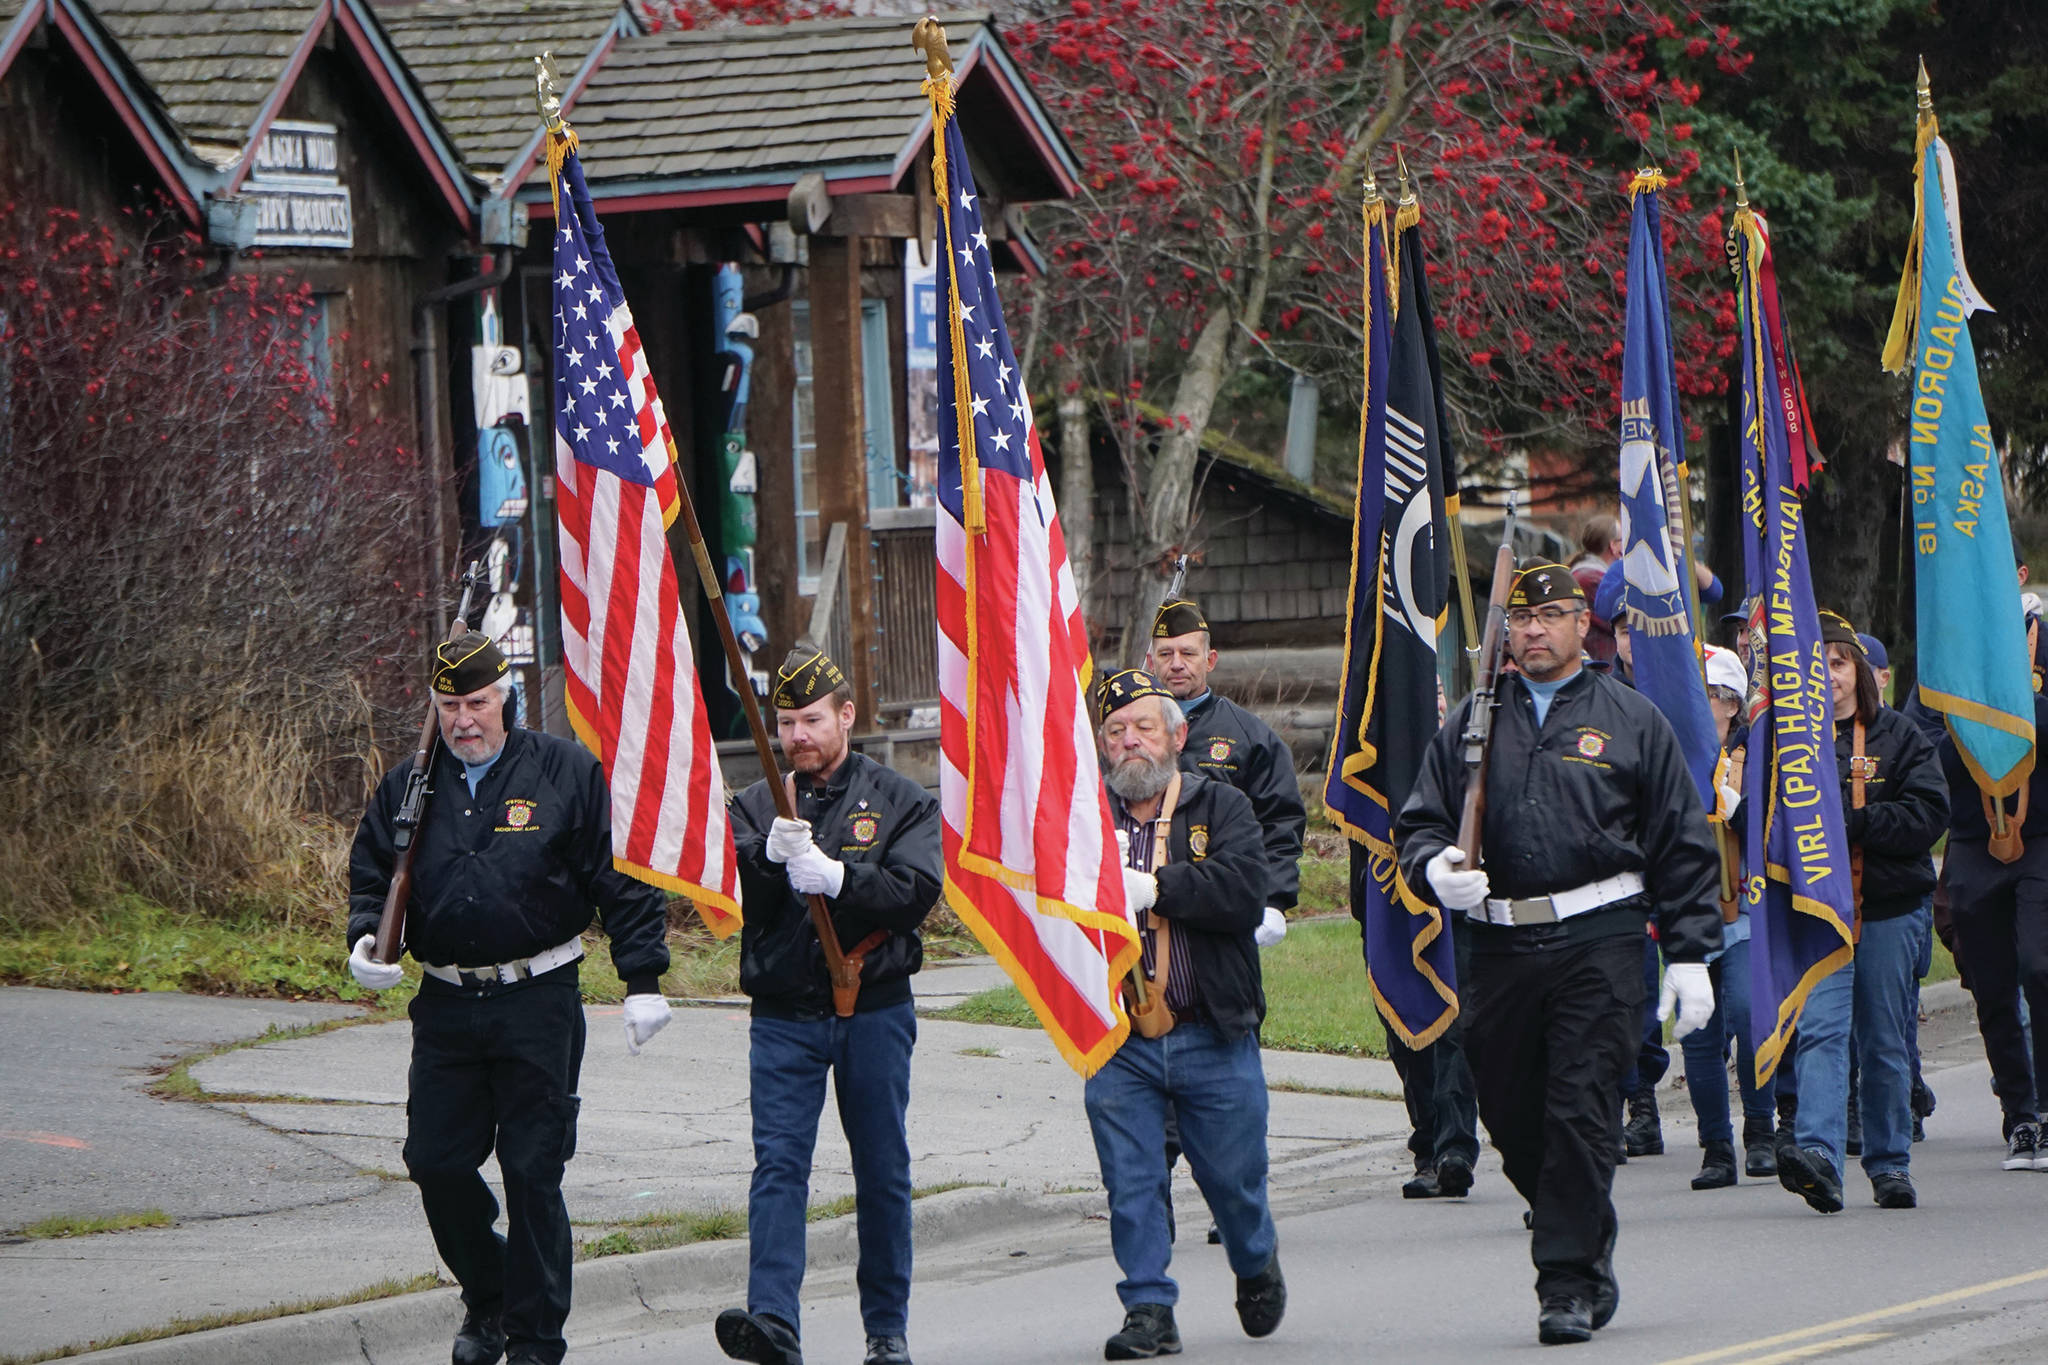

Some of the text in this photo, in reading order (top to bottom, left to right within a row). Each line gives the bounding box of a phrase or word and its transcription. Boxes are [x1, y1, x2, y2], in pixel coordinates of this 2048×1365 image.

[306, 136, 338, 170] WILD
[1771, 649, 1808, 734] HAGA
[1777, 743, 1822, 808] (PA)
[1793, 814, 1833, 885] VIRL
